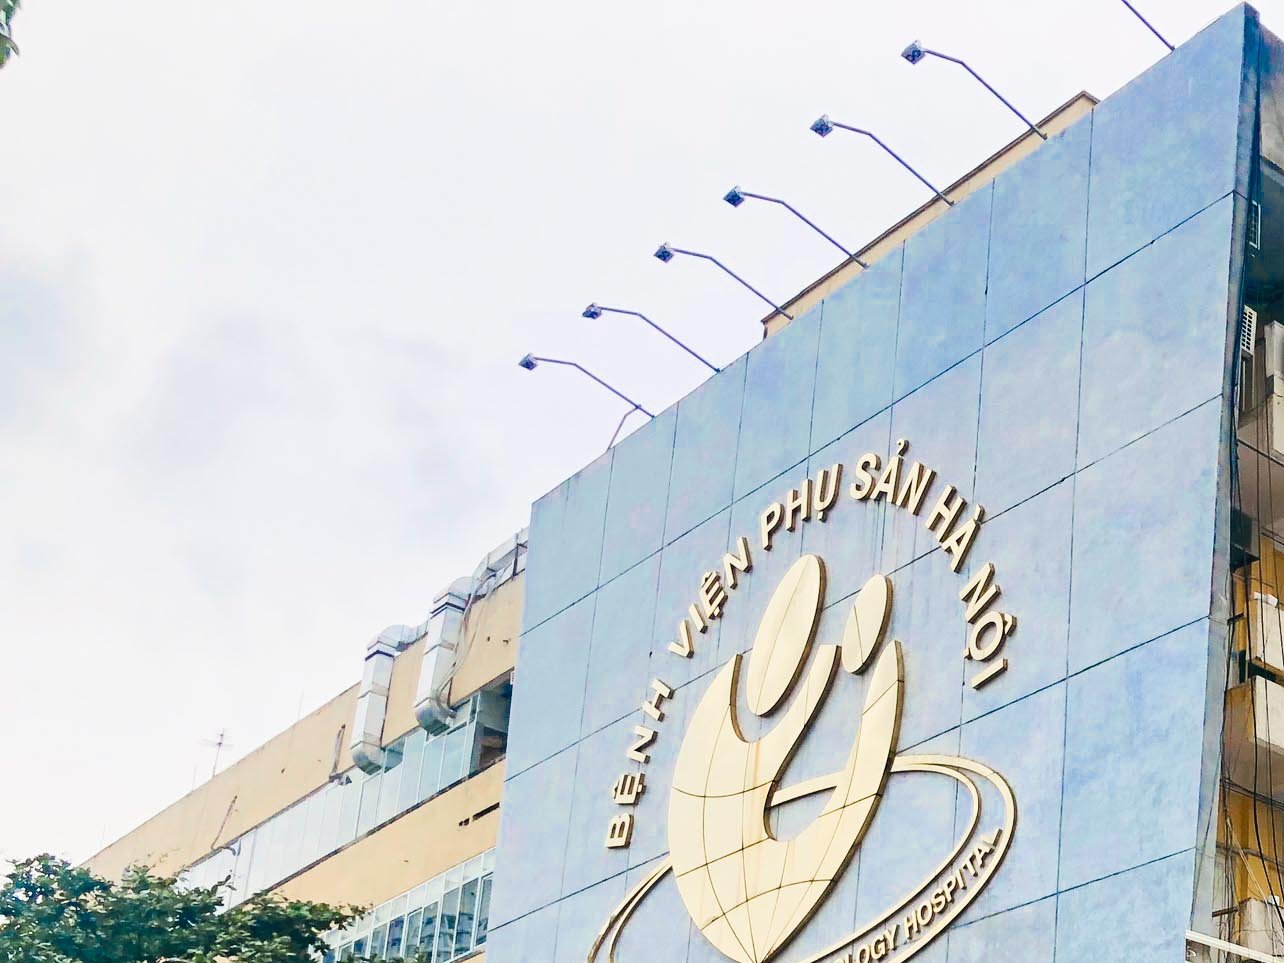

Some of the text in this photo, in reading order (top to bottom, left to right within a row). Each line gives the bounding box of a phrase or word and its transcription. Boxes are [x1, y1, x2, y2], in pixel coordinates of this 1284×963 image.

[606, 438, 1018, 849] BỆNH VIỆN PHỤ SẢN HÀ NỘI
[903, 828, 1004, 942] HOSPITAL
